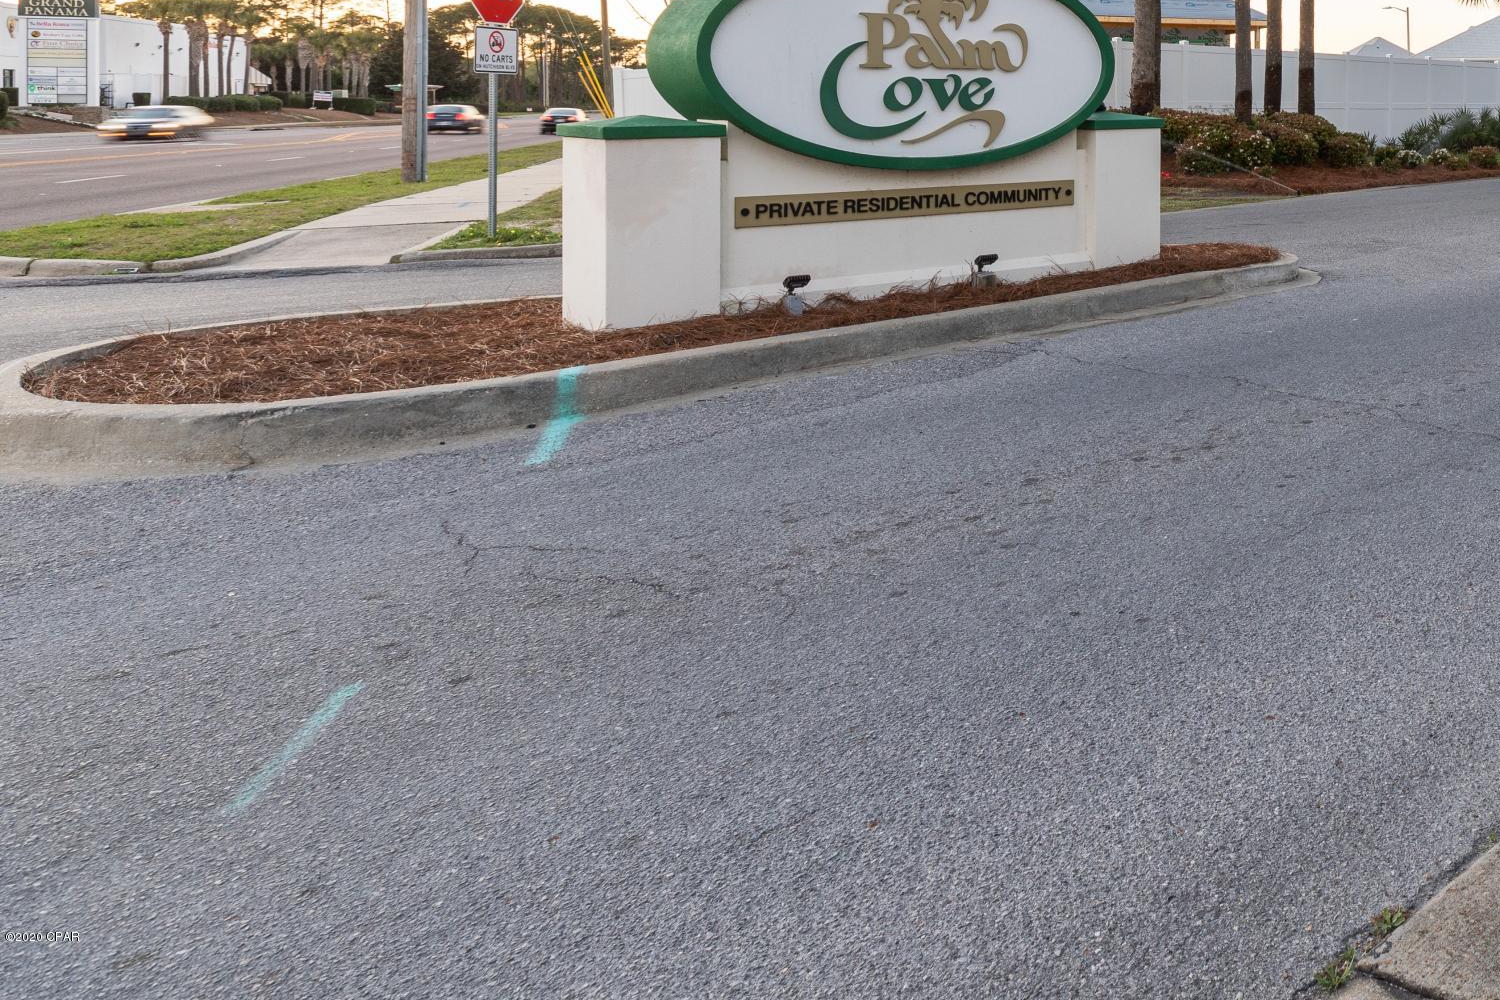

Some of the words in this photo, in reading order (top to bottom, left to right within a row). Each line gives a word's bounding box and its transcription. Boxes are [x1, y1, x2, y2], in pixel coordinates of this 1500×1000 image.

[24, 7, 88, 16] PANAMA
[479, 54, 490, 63] NO
[491, 54, 513, 64] CARTS
[819, 40, 996, 141] Cove
[754, 200, 839, 219] PRIVATE
[843, 193, 961, 215] RESIDENTIAL
[964, 187, 1063, 207] COMMUNITY
